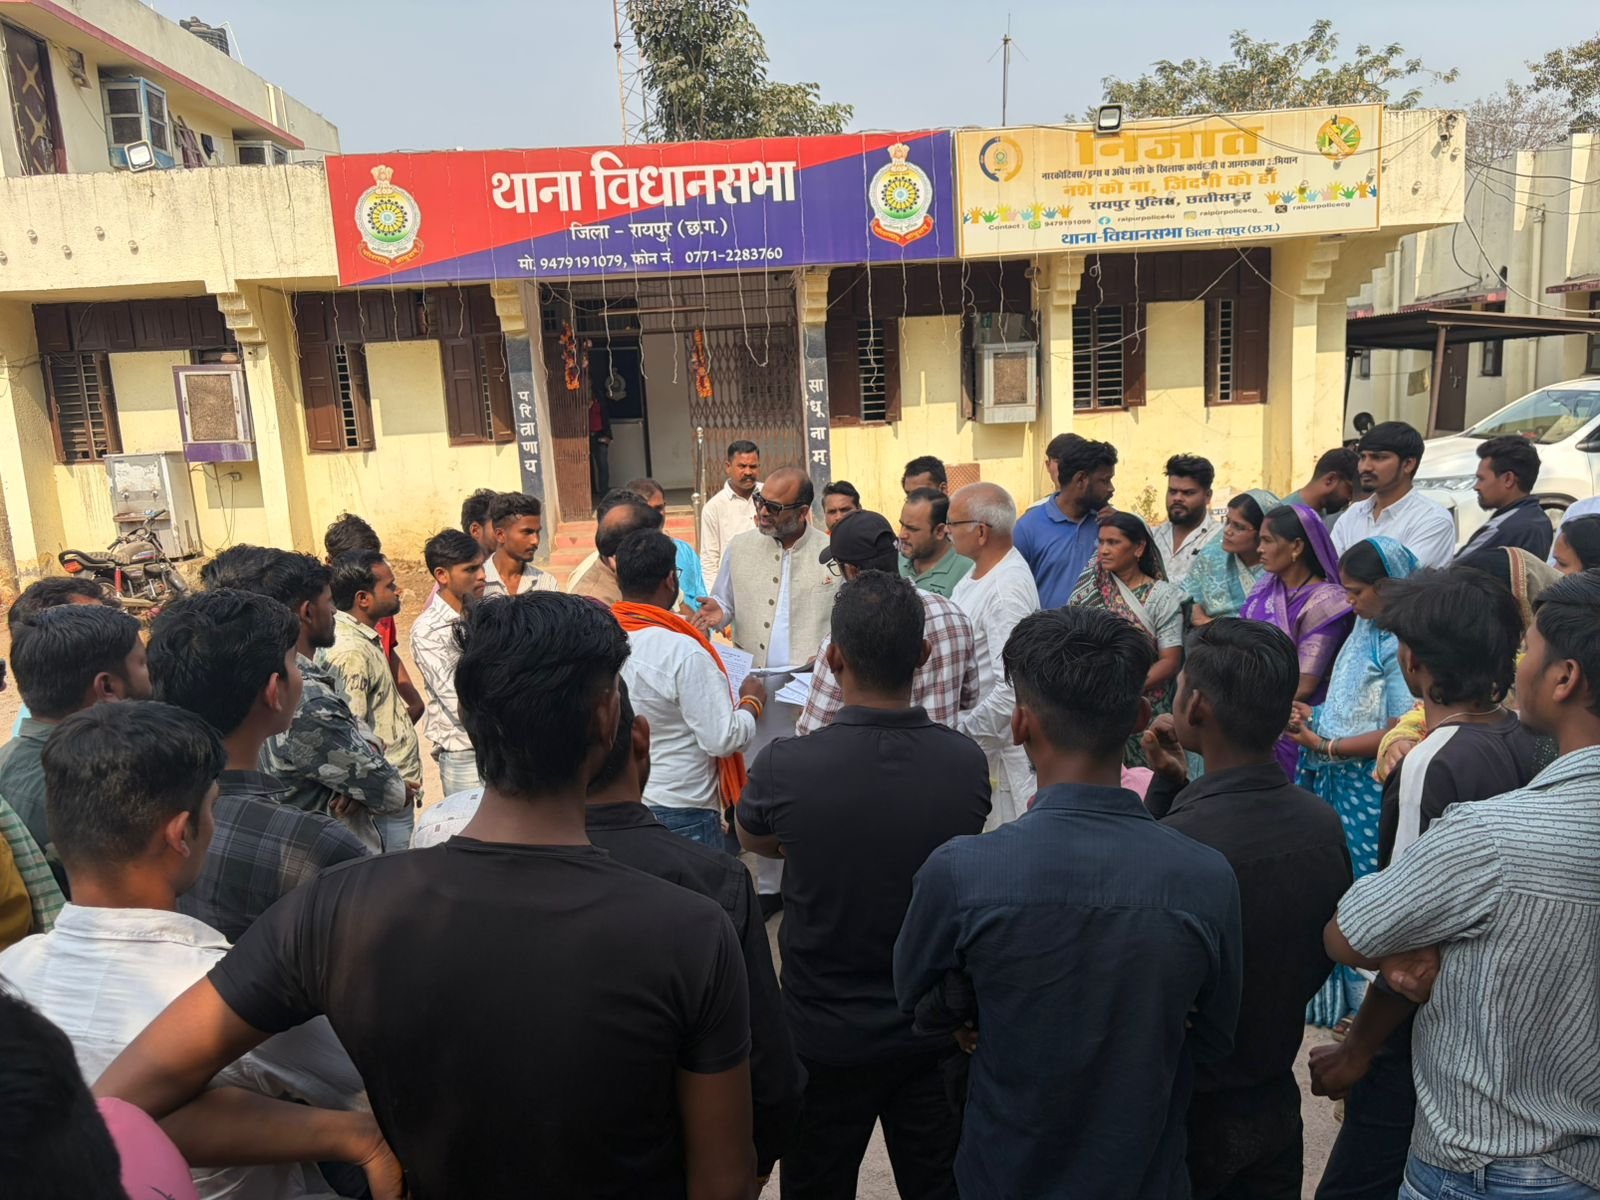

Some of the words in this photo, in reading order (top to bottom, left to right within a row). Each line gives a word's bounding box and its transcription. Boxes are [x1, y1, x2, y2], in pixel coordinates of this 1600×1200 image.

[1147, 164, 1155, 174] के
[1267, 155, 1298, 167] भियान
[491, 172, 582, 213] थाना
[590, 150, 796, 210] विधानसभा
[1063, 181, 1093, 197] नशे
[1099, 178, 1124, 195] को
[1163, 174, 1222, 191] जिंदगी
[1227, 170, 1252, 187] को
[1088, 199, 1131, 212] रायपुर
[568, 221, 610, 241] जिला
[628, 222, 673, 242] रायपुर
[677, 217, 728, 239] (छ.ग.)
[988, 223, 1020, 231] Contact
[517, 254, 536, 271] मो.
[540, 253, 628, 270] 9479191079,
[630, 249, 658, 266] फोन
[661, 248, 674, 265] नं.
[685, 247, 783, 264] 0771-2283760
